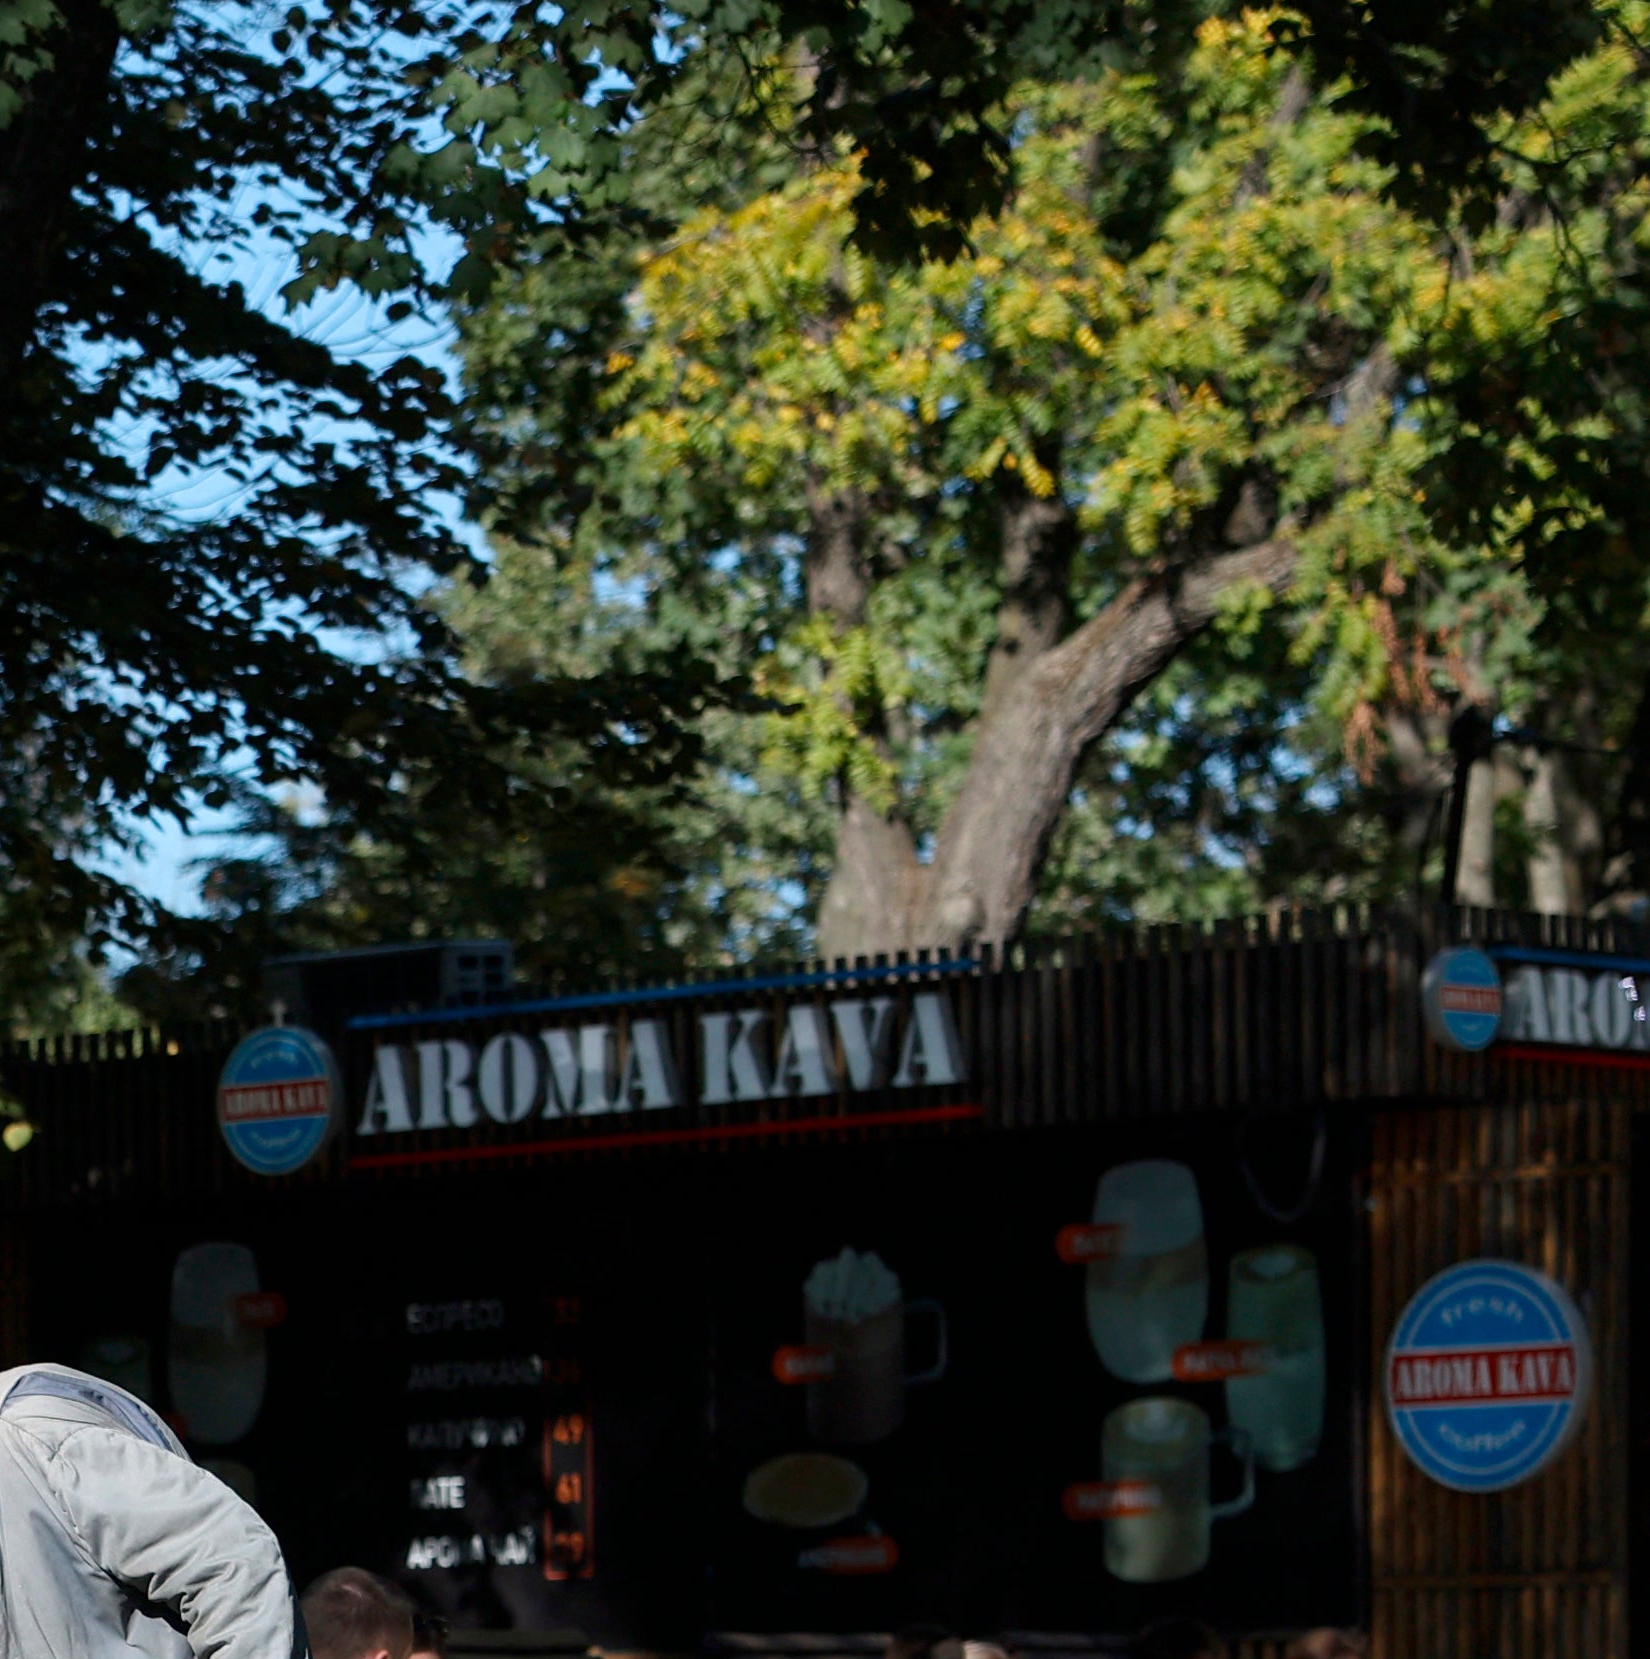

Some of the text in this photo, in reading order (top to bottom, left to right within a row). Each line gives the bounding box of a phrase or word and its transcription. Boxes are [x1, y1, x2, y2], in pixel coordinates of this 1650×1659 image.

[355, 990, 965, 1136] AROMA KAVA
[1395, 1349, 1575, 1400] AROMA KAVA
